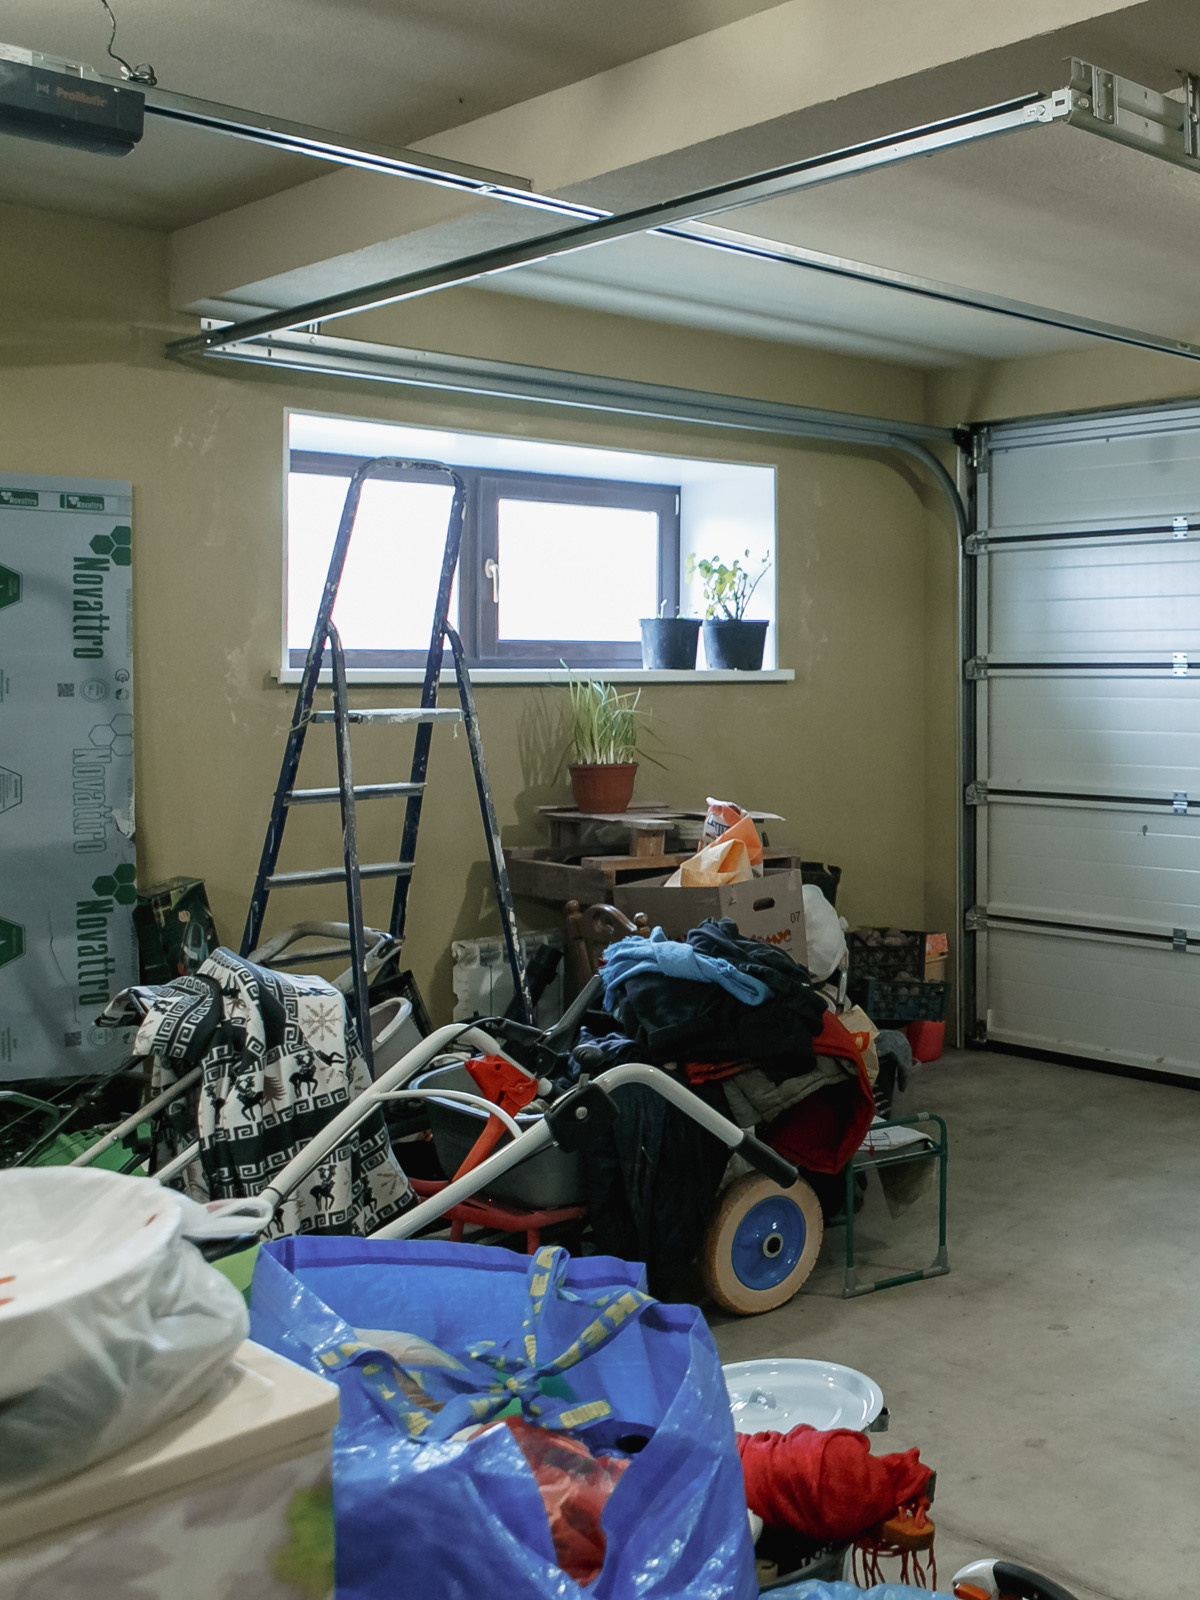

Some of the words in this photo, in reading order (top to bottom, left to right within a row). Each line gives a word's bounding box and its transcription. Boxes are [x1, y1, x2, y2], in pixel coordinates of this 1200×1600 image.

[72, 556, 110, 660] Novattro
[72, 748, 113, 855] Novattro
[76, 898, 116, 1006] Novattro
[790, 911, 801, 924] 07
